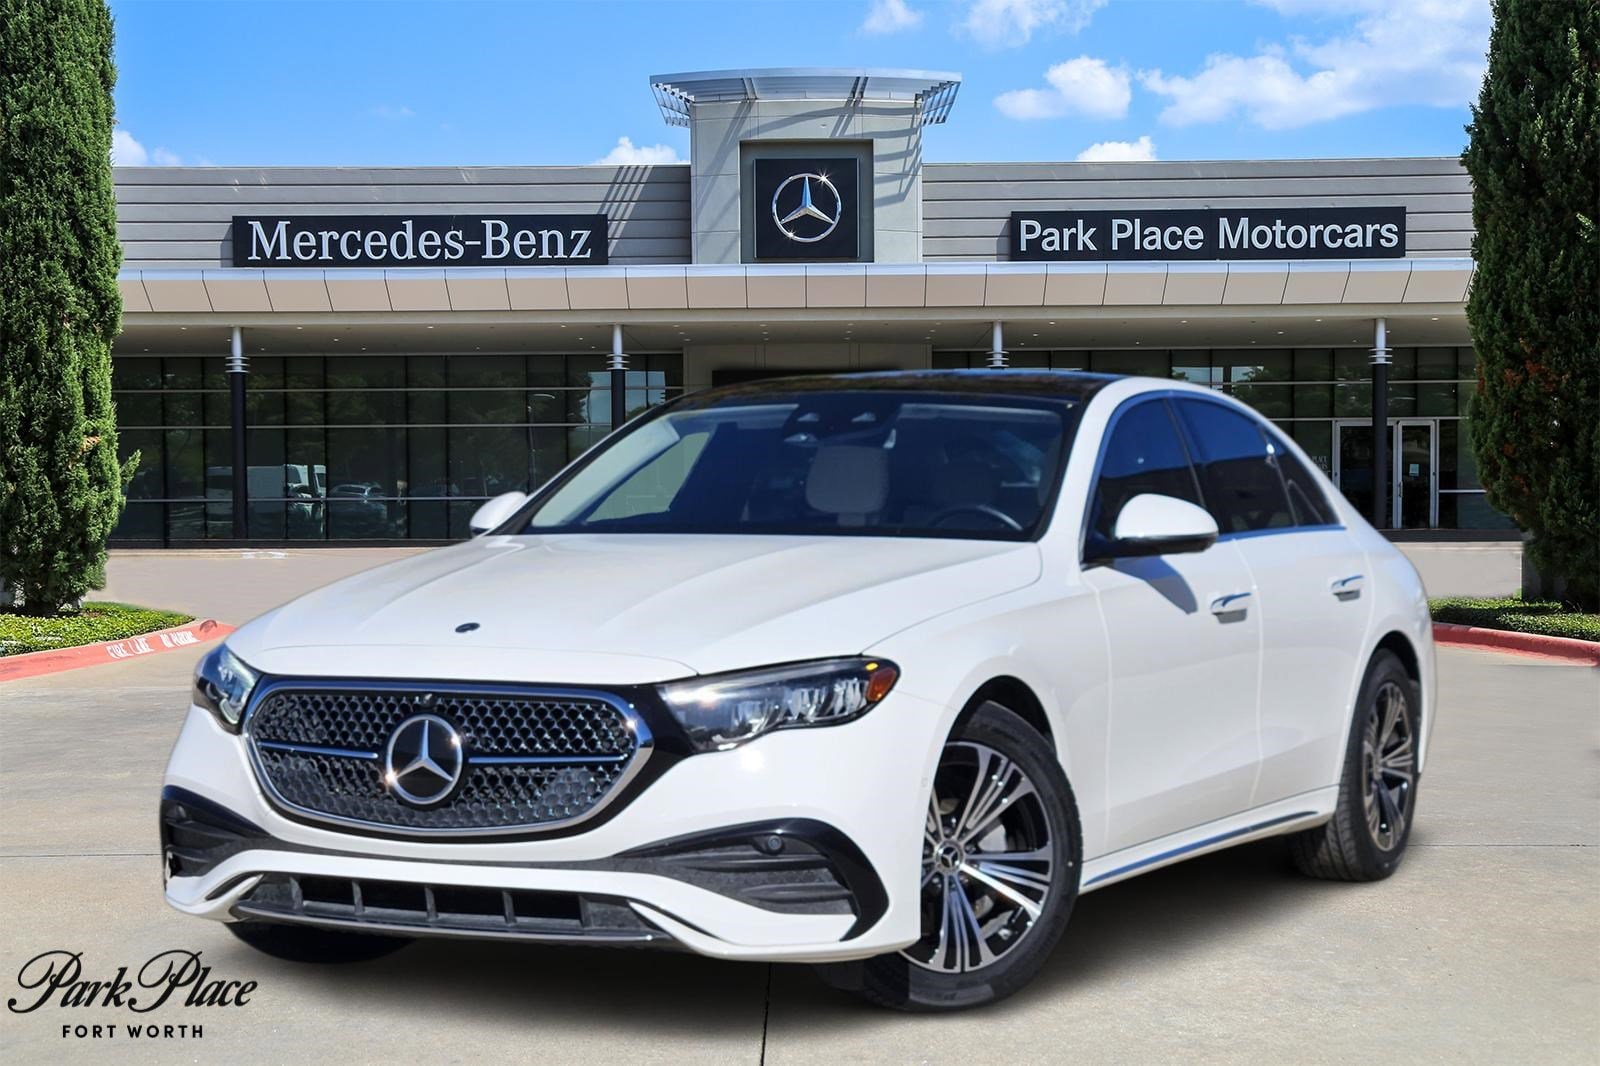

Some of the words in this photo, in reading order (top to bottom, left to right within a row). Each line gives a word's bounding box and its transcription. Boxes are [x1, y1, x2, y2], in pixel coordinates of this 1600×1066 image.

[247, 219, 593, 261] Mercedes-Benz
[1019, 219, 1098, 251] Park
[1111, 218, 1204, 251] Place
[1218, 217, 1400, 250] Motorcars
